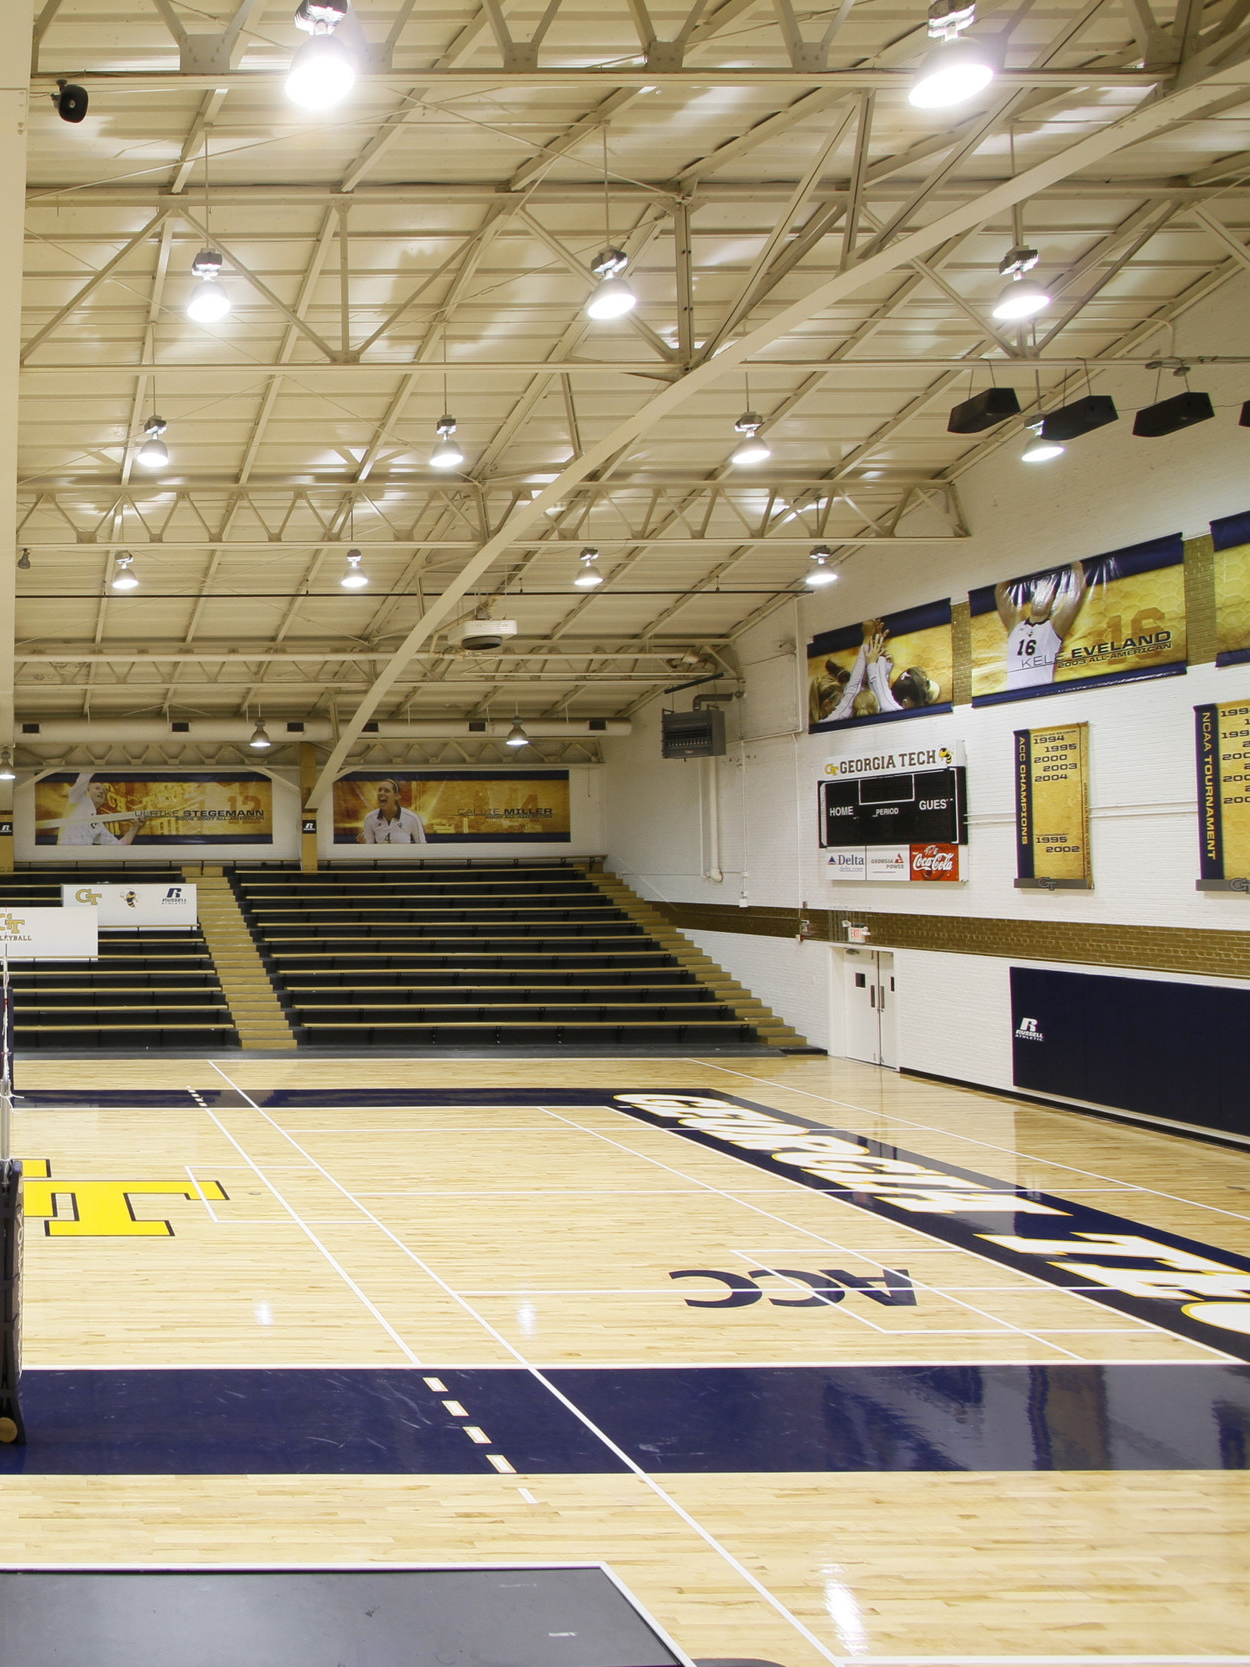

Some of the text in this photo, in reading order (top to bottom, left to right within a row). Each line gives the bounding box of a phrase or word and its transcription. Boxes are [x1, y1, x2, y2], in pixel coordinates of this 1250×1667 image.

[1017, 639, 1037, 656] 16
[1071, 630, 1171, 659] EVELAND
[1058, 642, 1172, 669] 2003 ALL-AMERICAN
[1220, 707, 1250, 717] 199
[1033, 735, 1065, 745] 1994
[1045, 743, 1077, 753] 1995
[840, 755, 896, 774] GEORGIA
[899, 750, 936, 767] TECH
[1034, 754, 1067, 763] 2000
[1043, 763, 1078, 772] 2003
[1034, 774, 1068, 782] 2004
[1202, 712, 1216, 860] NCAA TOURNAMENT
[919, 799, 950, 811] GUES
[1019, 764, 1029, 845] CHAMPIONS
[830, 806, 854, 816] HOME
[876, 807, 899, 816] PERIOD
[838, 854, 864, 865] Delta
[912, 852, 954, 871] Coca-Cola
[612, 1093, 1074, 1217] GEORGIA
[668, 1268, 918, 1309] ACC
